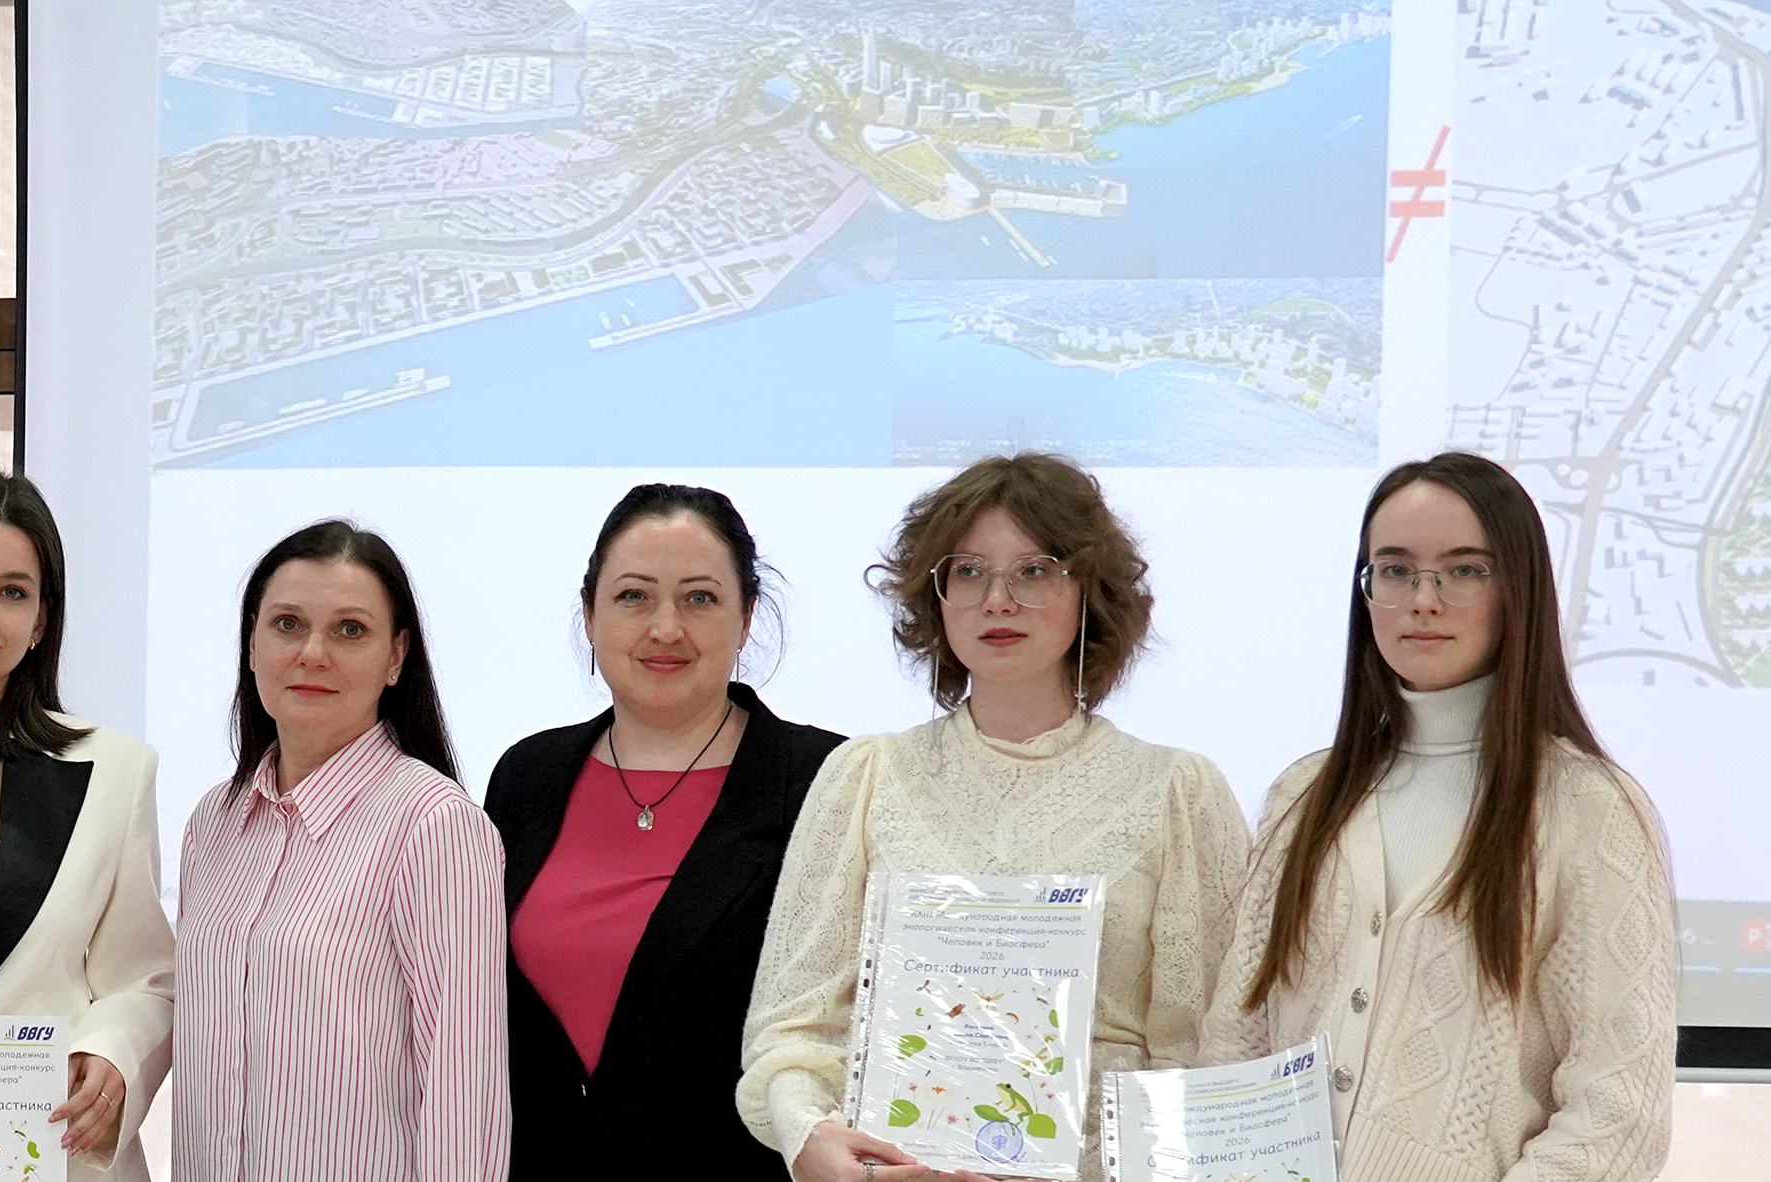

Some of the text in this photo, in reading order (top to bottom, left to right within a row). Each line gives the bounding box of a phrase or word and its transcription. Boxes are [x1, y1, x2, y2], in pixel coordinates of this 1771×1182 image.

[1047, 887, 1089, 903] ВВГУ
[1020, 914, 1081, 923] молодежная
[902, 924, 1087, 937] экологическая конференция-конкурс
[979, 951, 1005, 961] 2026
[16, 1026, 55, 1041] ВВГУ
[1282, 1051, 1315, 1078] ВВГУ
[1229, 1126, 1236, 1134] и
[1224, 1136, 1251, 1147] 2026
[1249, 1130, 1321, 1161] участника
